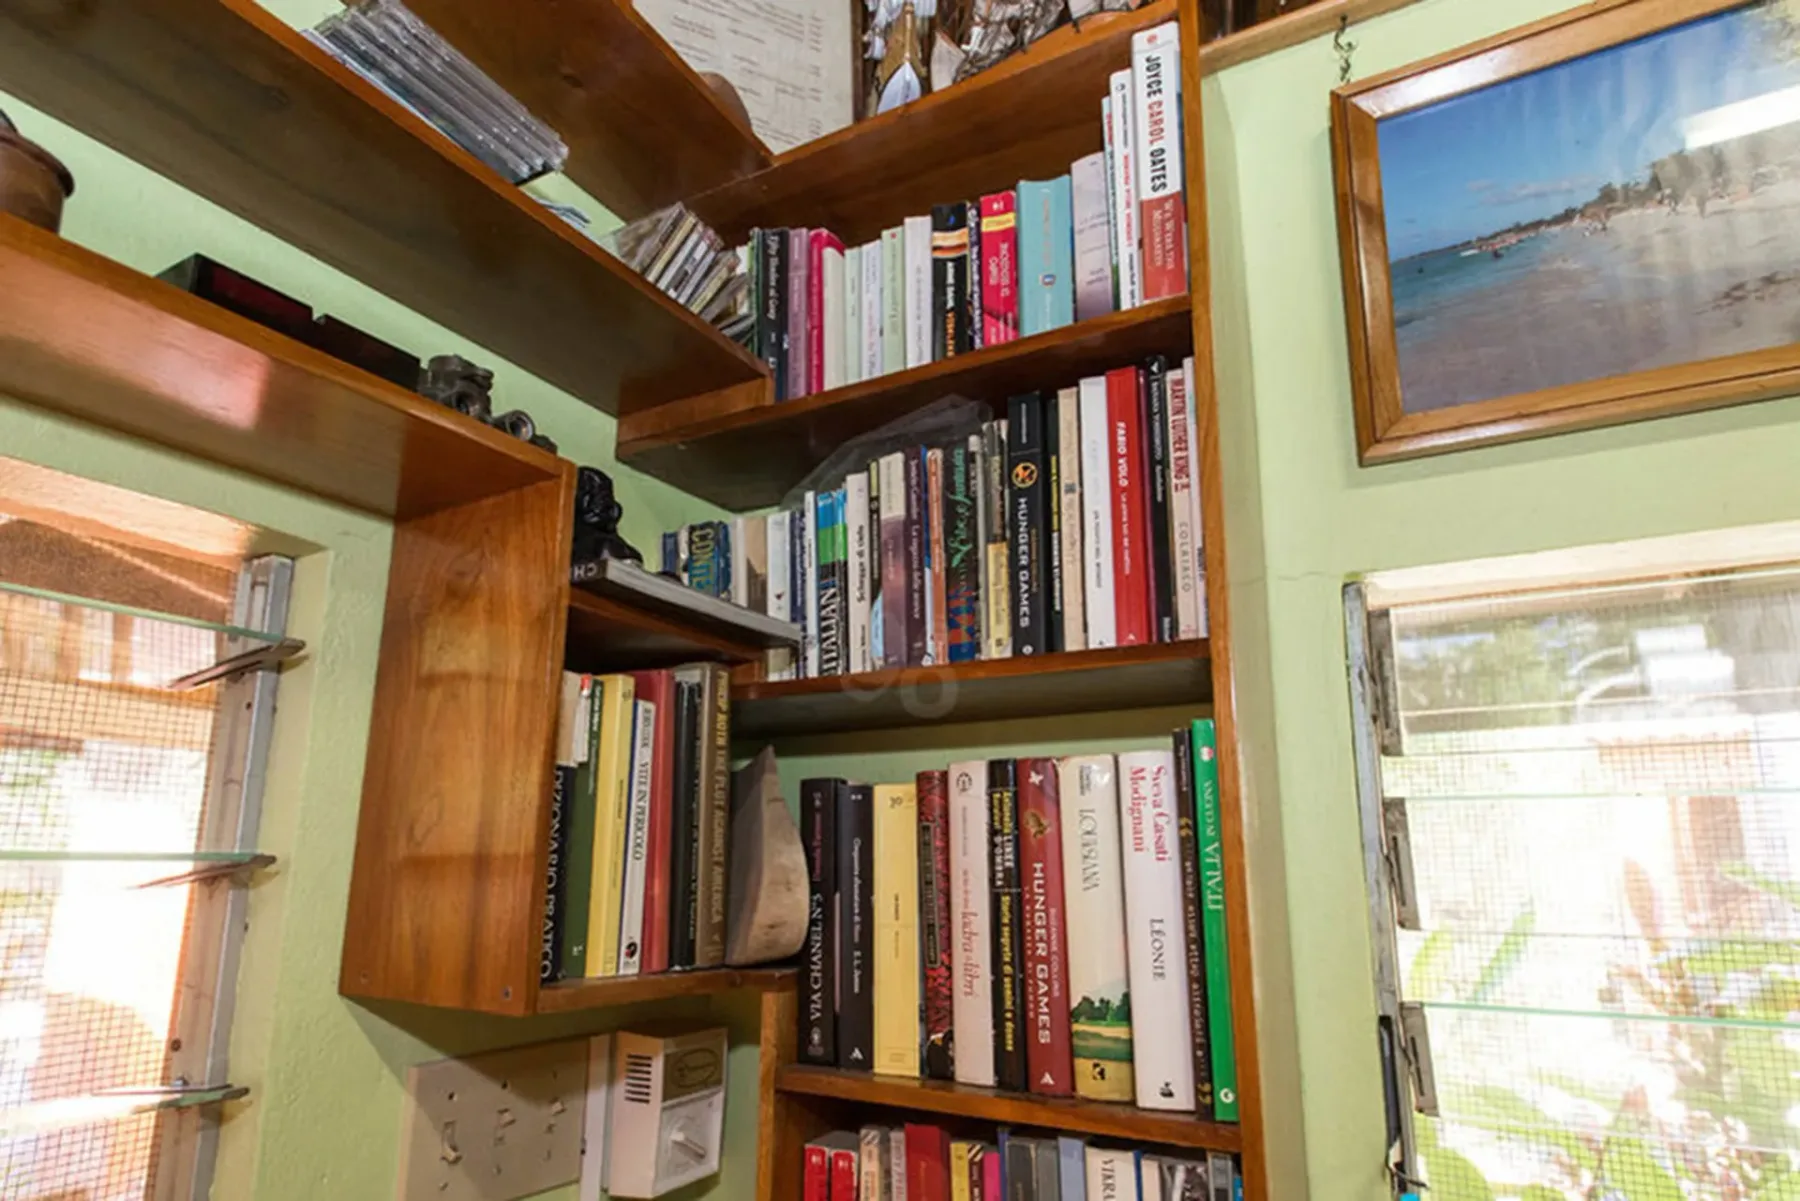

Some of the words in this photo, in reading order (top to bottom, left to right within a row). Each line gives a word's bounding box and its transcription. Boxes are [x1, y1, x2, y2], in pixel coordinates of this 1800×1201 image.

[1144, 55, 1165, 98] JOYCE
[1147, 100, 1166, 145] CAROL
[1149, 147, 1168, 193] OATES
[769, 257, 779, 286] Shades
[1171, 379, 1187, 415] MARTIN
[1116, 421, 1128, 454] FABIO
[1173, 419, 1189, 454] LUTHER
[1118, 457, 1130, 488] VOLO
[1175, 456, 1190, 481] KING
[1016, 497, 1030, 566] HUNGER
[1018, 570, 1031, 628] GAMES
[819, 588, 839, 670] ITALIAN
[638, 761, 649, 786] VITE
[1151, 764, 1168, 810] Sveva
[637, 789, 648, 805] IN
[1126, 766, 1148, 853] Modignani
[635, 805, 647, 861] PERICOLO
[1153, 811, 1173, 862] Casati
[1203, 841, 1224, 910] ITALIA
[961, 911, 978, 952] ladra
[1032, 862, 1049, 957] HUNGER
[810, 921, 823, 990] CHANEL
[1149, 918, 1167, 981] LÉONIE
[963, 961, 980, 997] libri
[811, 992, 823, 1021] VIA
[1036, 964, 1052, 1045] GAMES
